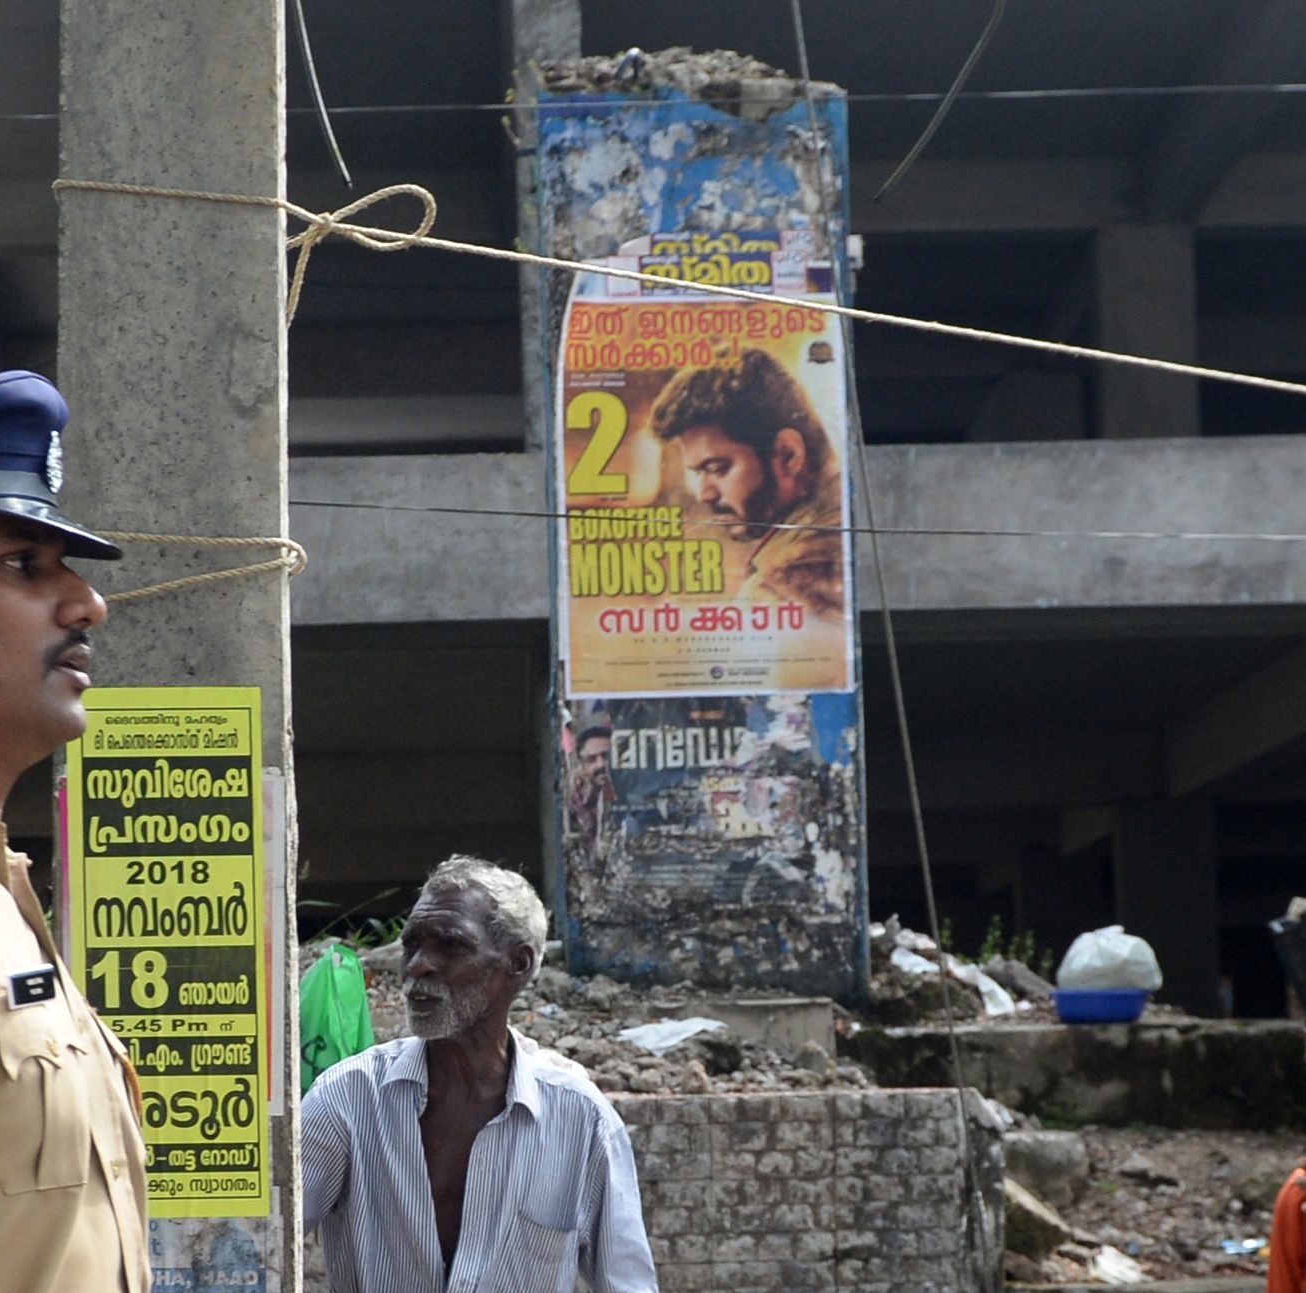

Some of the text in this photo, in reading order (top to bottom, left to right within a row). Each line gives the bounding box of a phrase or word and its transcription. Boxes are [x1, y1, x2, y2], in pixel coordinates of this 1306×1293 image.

[568, 306, 827, 340] ഇത് ജനങ്ങളുടെ
[564, 390, 629, 496] 2
[568, 506, 683, 542] BOXOFFICE
[570, 539, 724, 597] MONSTER
[86, 758, 249, 809] സുവിശേഷ
[88, 813, 251, 854] പ്രസംഗം
[125, 860, 211, 885] 2018
[92, 881, 249, 938] നവംബർ
[91, 949, 170, 1010] 18
[178, 974, 250, 1006] ഞായർ
[111, 1018, 163, 1034] 5.45
[171, 1018, 208, 1033] Pm
[190, 1177, 257, 1193] സ്വാഗതം
